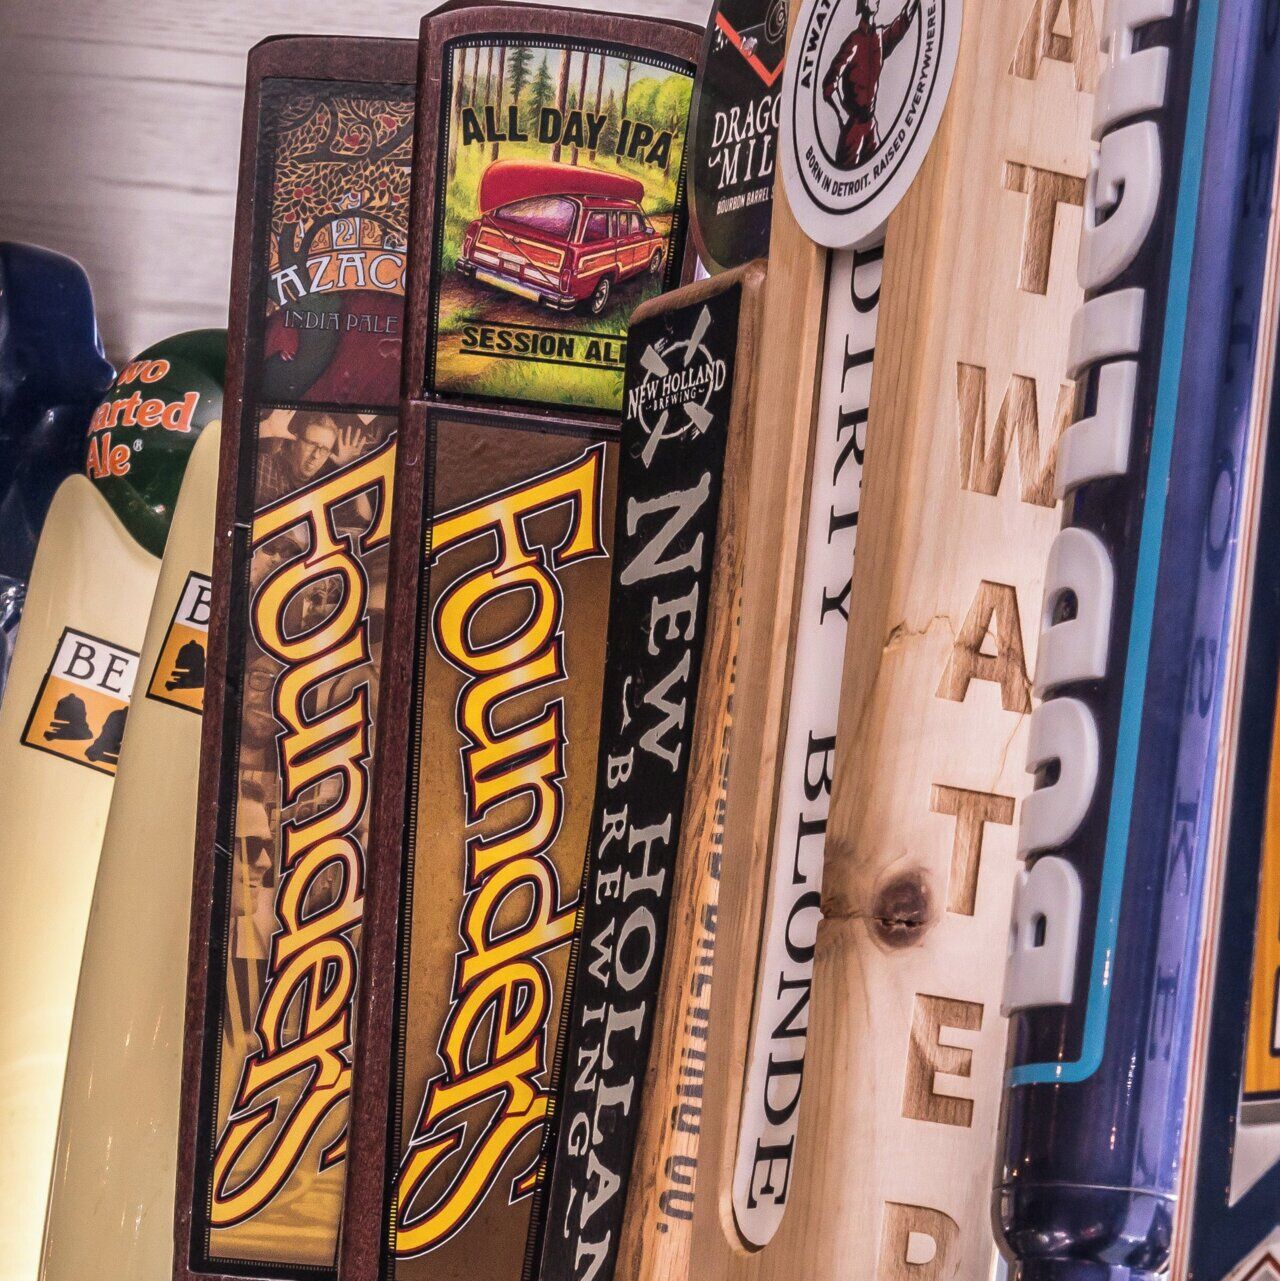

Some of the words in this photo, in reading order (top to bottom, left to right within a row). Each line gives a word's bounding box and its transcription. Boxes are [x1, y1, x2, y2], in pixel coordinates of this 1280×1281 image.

[801, 0, 832, 89] ATWA
[461, 105, 529, 147] ALL
[538, 106, 608, 151] DAY
[615, 118, 674, 170] IPA
[711, 93, 782, 148] DRAGO
[718, 134, 773, 190] MIL
[805, 146, 824, 184] BORN
[822, 173, 832, 192] IN
[832, 173, 871, 197] DETROIT.
[873, 131, 907, 180] RAISED
[716, 195, 745, 215] BOURBON
[746, 186, 769, 204] BARREL
[272, 252, 407, 306] AZAC
[1055, 0, 1175, 500] LIGH
[284, 310, 340, 331] INDIA
[346, 312, 399, 334] PALE
[461, 326, 572, 361] SESSION
[108, 359, 171, 389] wo
[627, 380, 659, 420] NEW
[662, 359, 726, 396] HOLLAND
[653, 387, 697, 411] BREWING
[87, 391, 200, 437] arted
[619, 470, 712, 773] NEW
[62, 640, 133, 698] BE
[1002, 527, 1113, 1018] BUD
[210, 430, 398, 1229] Founders
[394, 441, 610, 1259] Founders
[567, 747, 634, 1157] BREWING
[746, 730, 836, 1210] BLONDE
